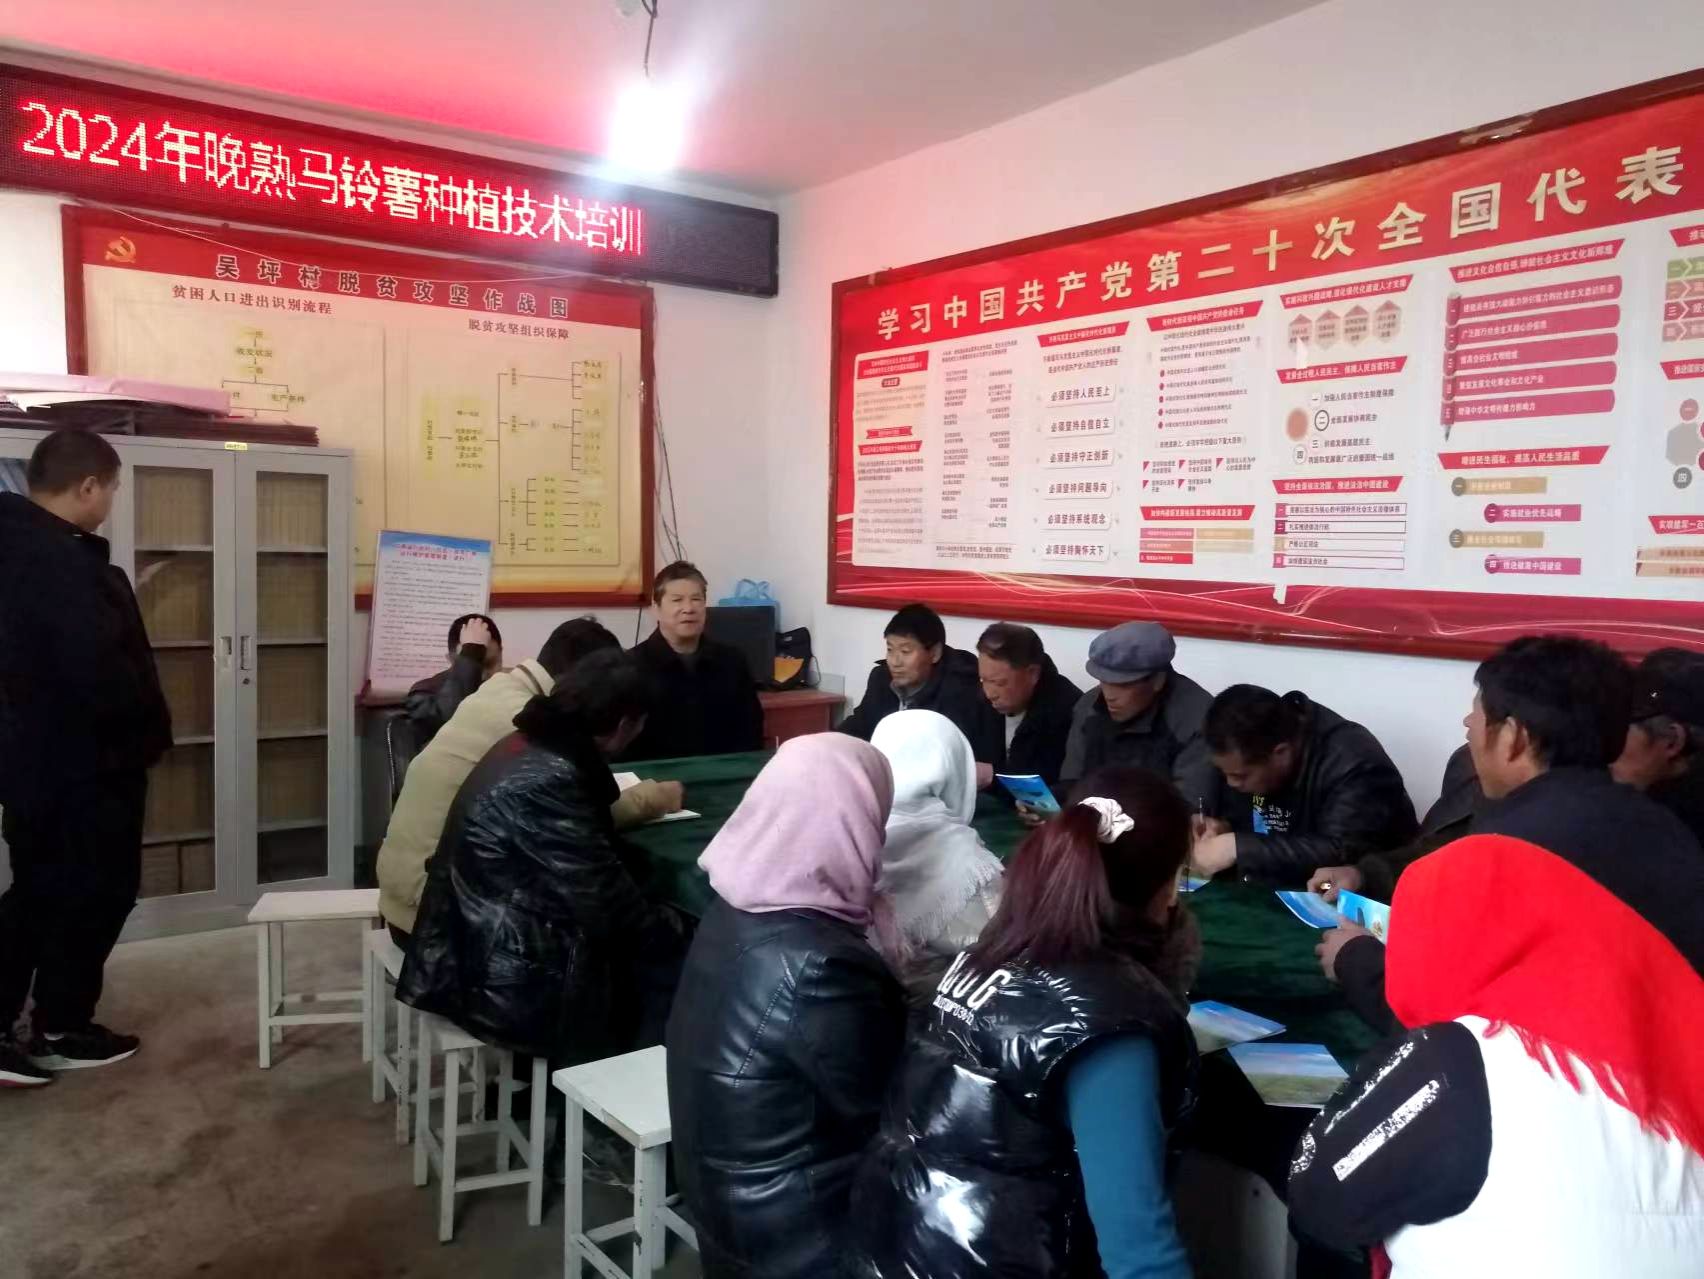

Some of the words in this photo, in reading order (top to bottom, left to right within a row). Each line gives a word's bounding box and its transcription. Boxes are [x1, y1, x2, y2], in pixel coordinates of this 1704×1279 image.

[20, 100, 643, 256] 2024年晚熟马铃薯种植技术培训
[877, 145, 1685, 342] 学习中国共产党第二十次全国代表
[171, 283, 334, 316] 贫困人口进出识别流程
[215, 254, 569, 318] 吴坪村脱贫攻坚作战图
[468, 317, 571, 341] 脱贫攻坚组织保障
[1051, 385, 1110, 402] 必须坚持人民至上
